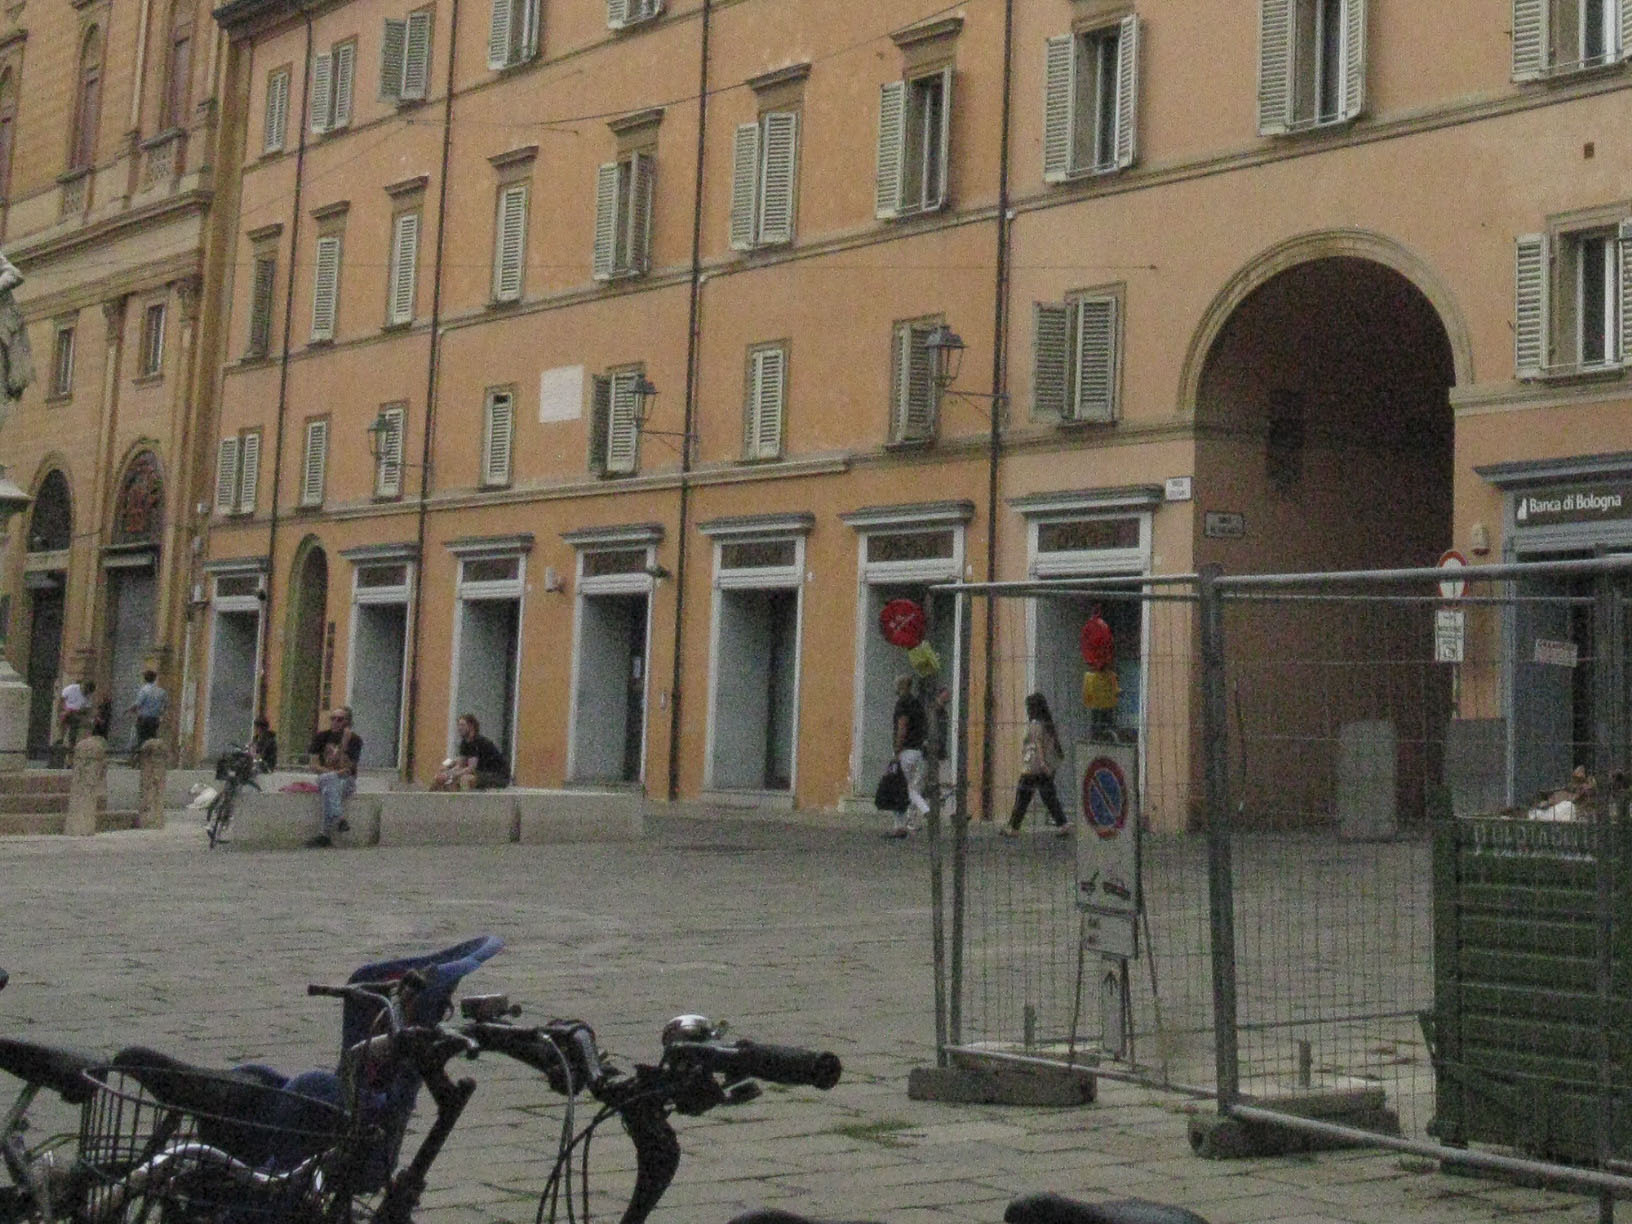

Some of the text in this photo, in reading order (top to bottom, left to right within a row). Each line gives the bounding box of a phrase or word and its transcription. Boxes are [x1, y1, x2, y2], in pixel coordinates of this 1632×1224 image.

[1528, 491, 1622, 514] Banca di Bologna
